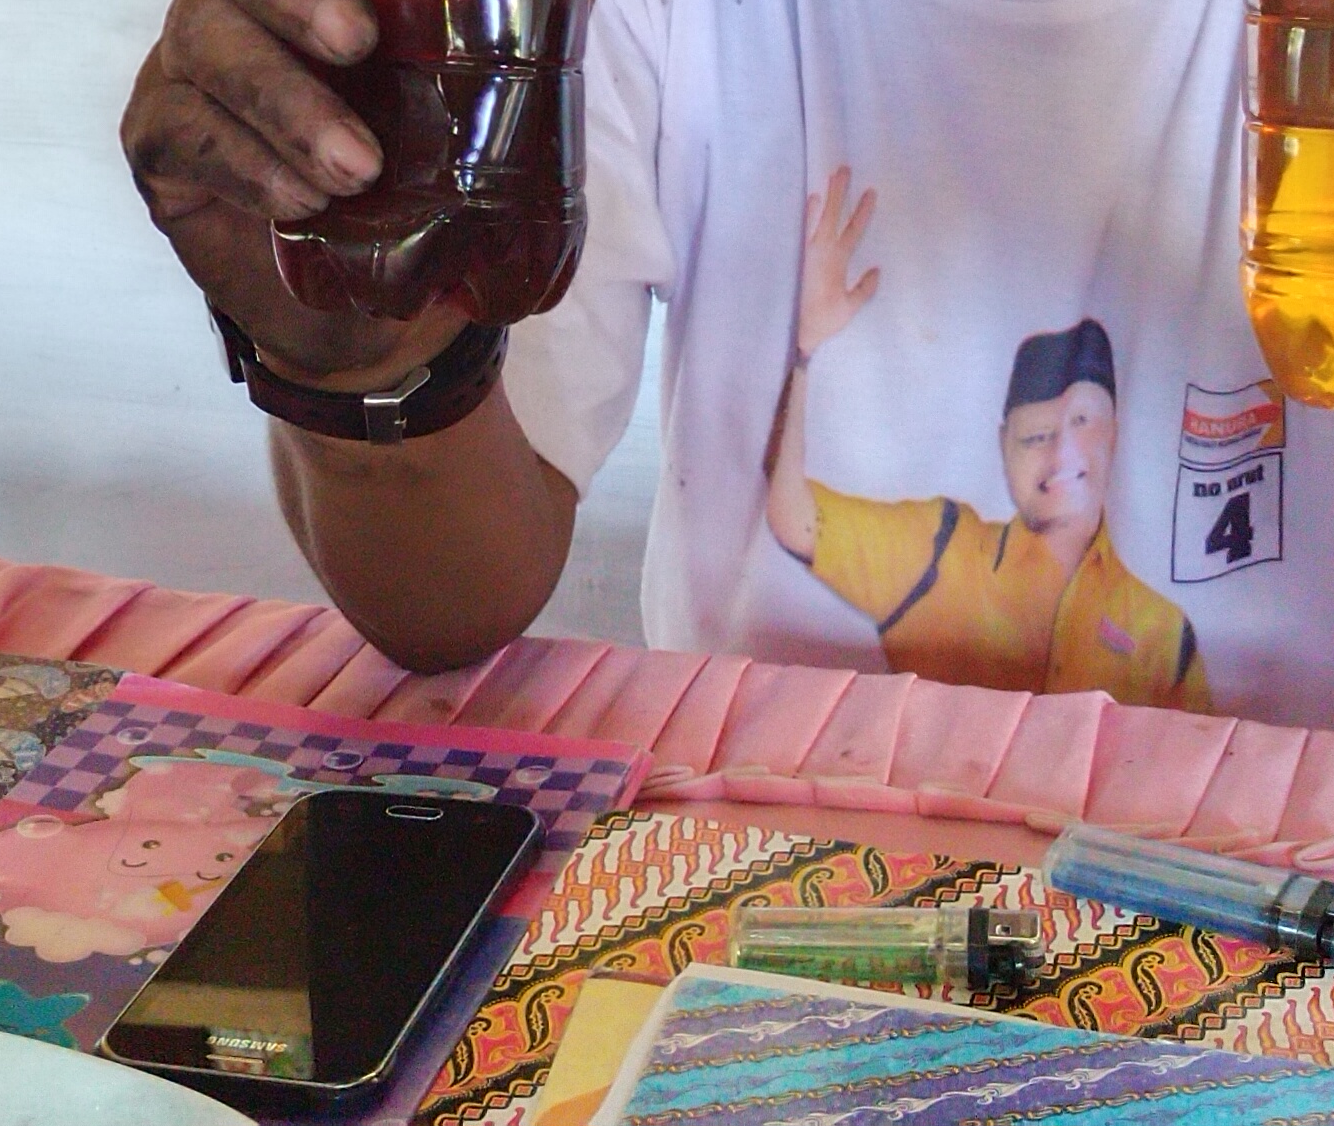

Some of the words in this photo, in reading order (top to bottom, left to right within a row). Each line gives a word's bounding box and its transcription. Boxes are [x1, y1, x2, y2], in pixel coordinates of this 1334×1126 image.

[1193, 482, 1221, 497] no
[1205, 491, 1254, 564] 4
[205, 1035, 288, 1053] SAMSUNG
